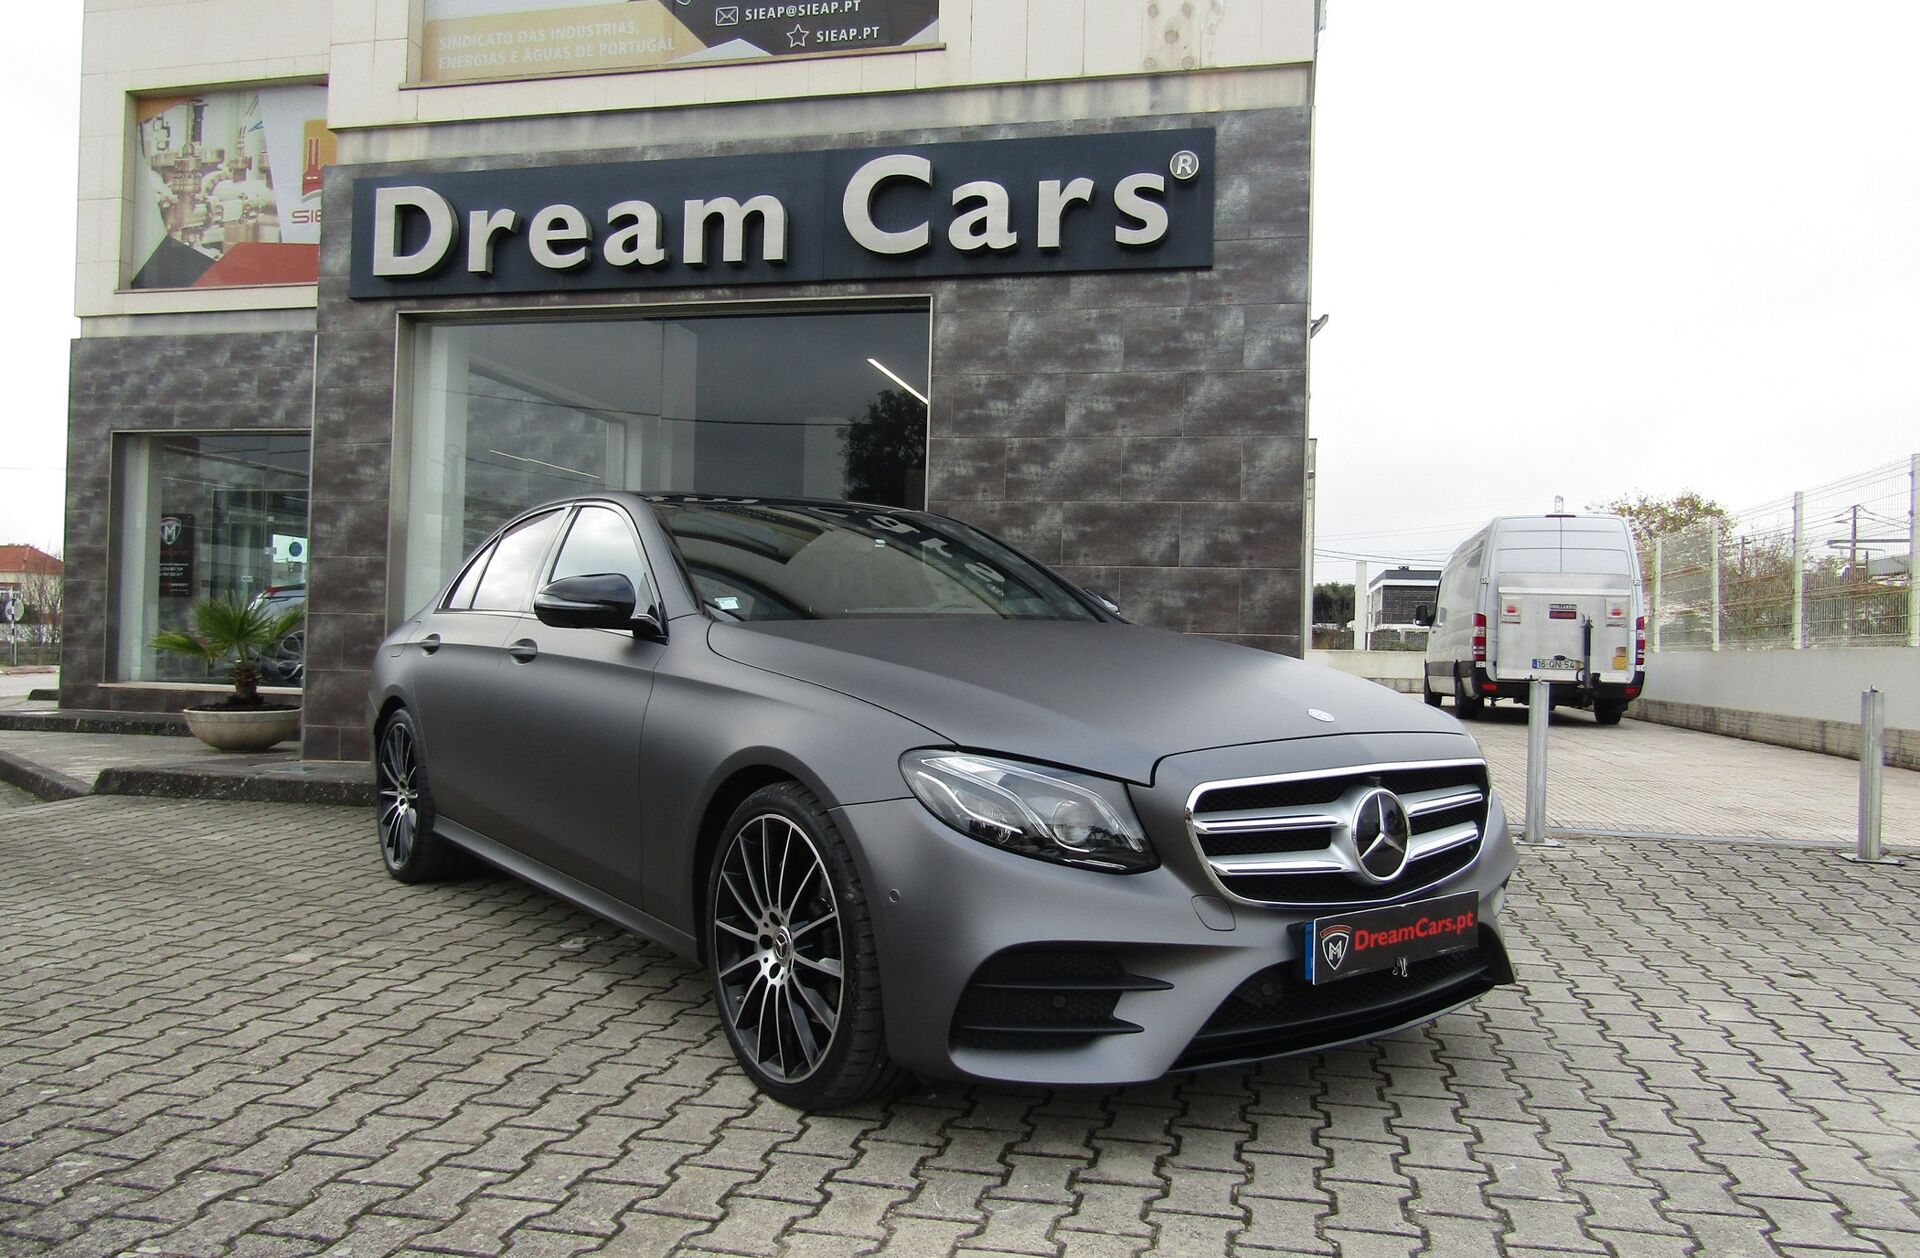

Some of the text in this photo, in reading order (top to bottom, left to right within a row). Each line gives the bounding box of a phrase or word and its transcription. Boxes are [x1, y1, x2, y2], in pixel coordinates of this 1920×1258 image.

[744, 0, 861, 21] SIEAP@SIEAP.PT
[439, 32, 513, 51] SINDICATO
[518, 28, 546, 43] DAS
[816, 26, 880, 43] SIEAP.PT
[438, 51, 506, 71] ENERGIAS
[511, 49, 519, 64] E
[576, 43, 594, 58] DE
[373, 186, 788, 278] Dream
[1354, 910, 1474, 950] DreamCars.pt
